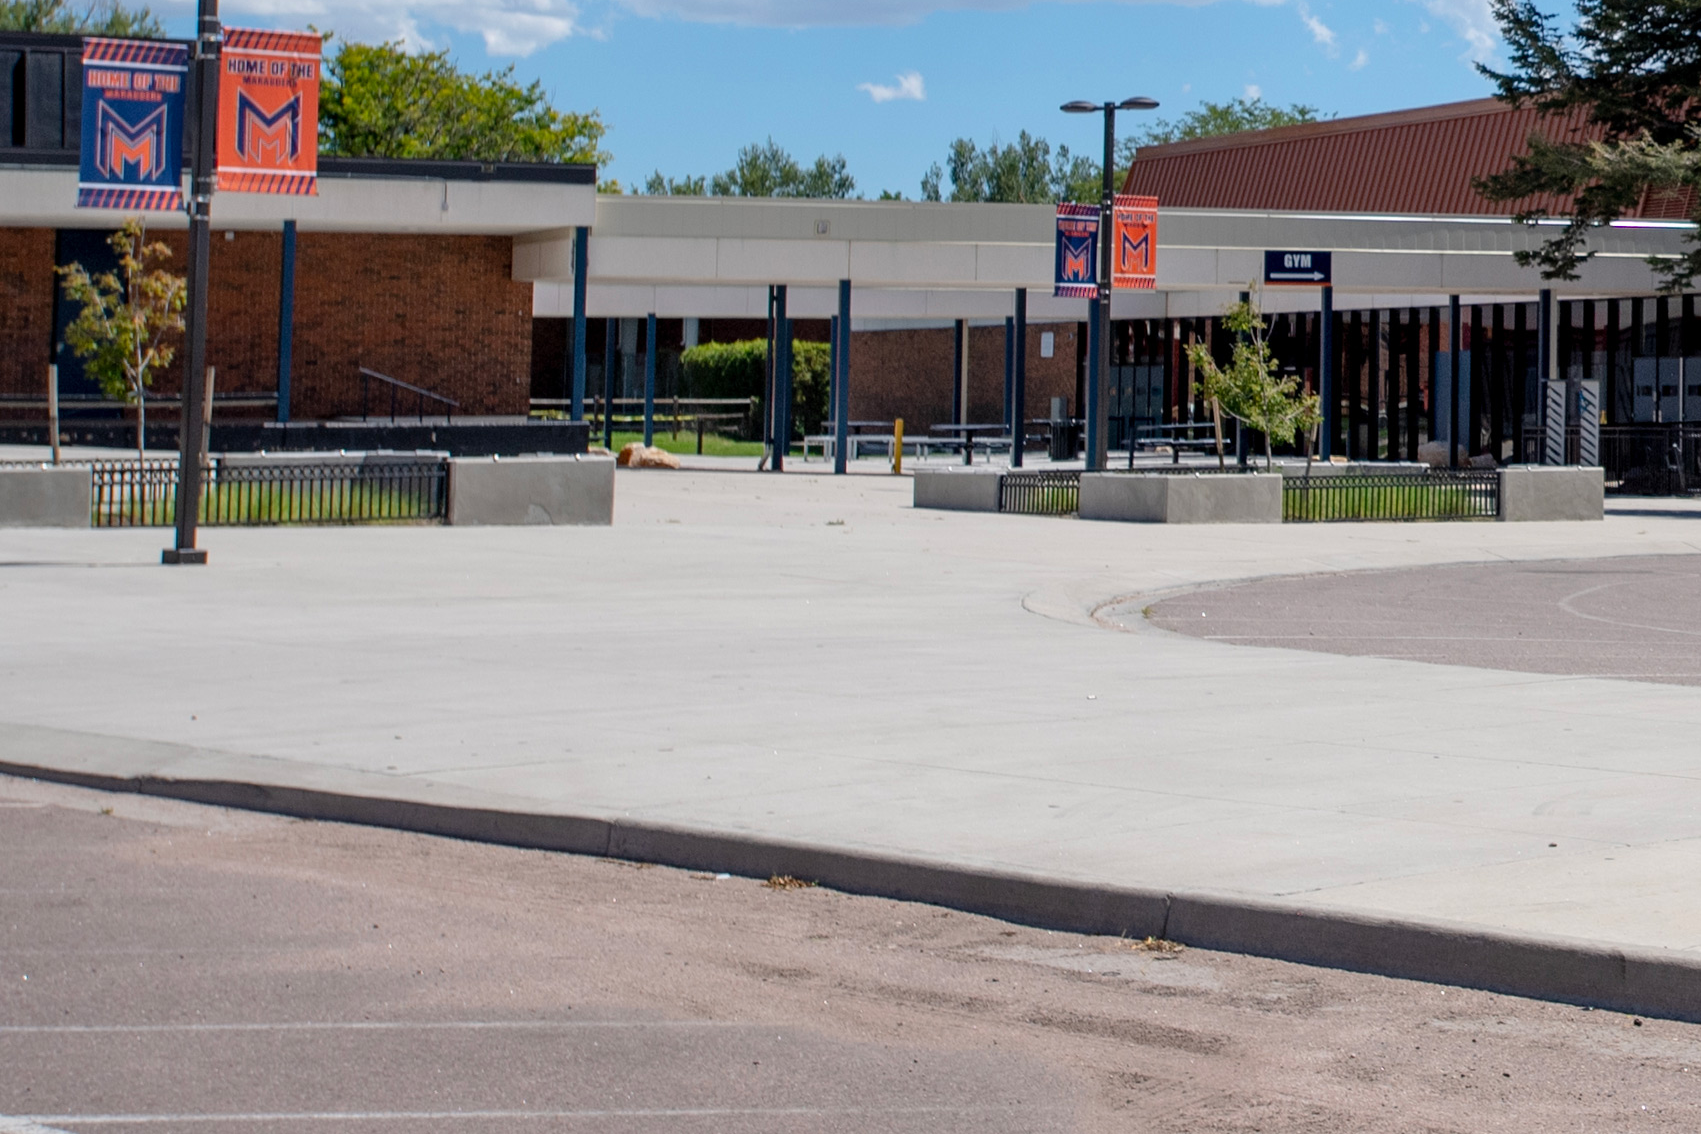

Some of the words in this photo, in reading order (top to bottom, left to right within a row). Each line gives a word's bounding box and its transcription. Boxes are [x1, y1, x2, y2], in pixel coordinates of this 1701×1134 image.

[88, 69, 131, 89] HOME
[133, 72, 153, 90] OF
[228, 58, 267, 76] HOME
[270, 61, 288, 77] OF
[290, 62, 315, 80] THE
[1283, 253, 1312, 268] GYM
